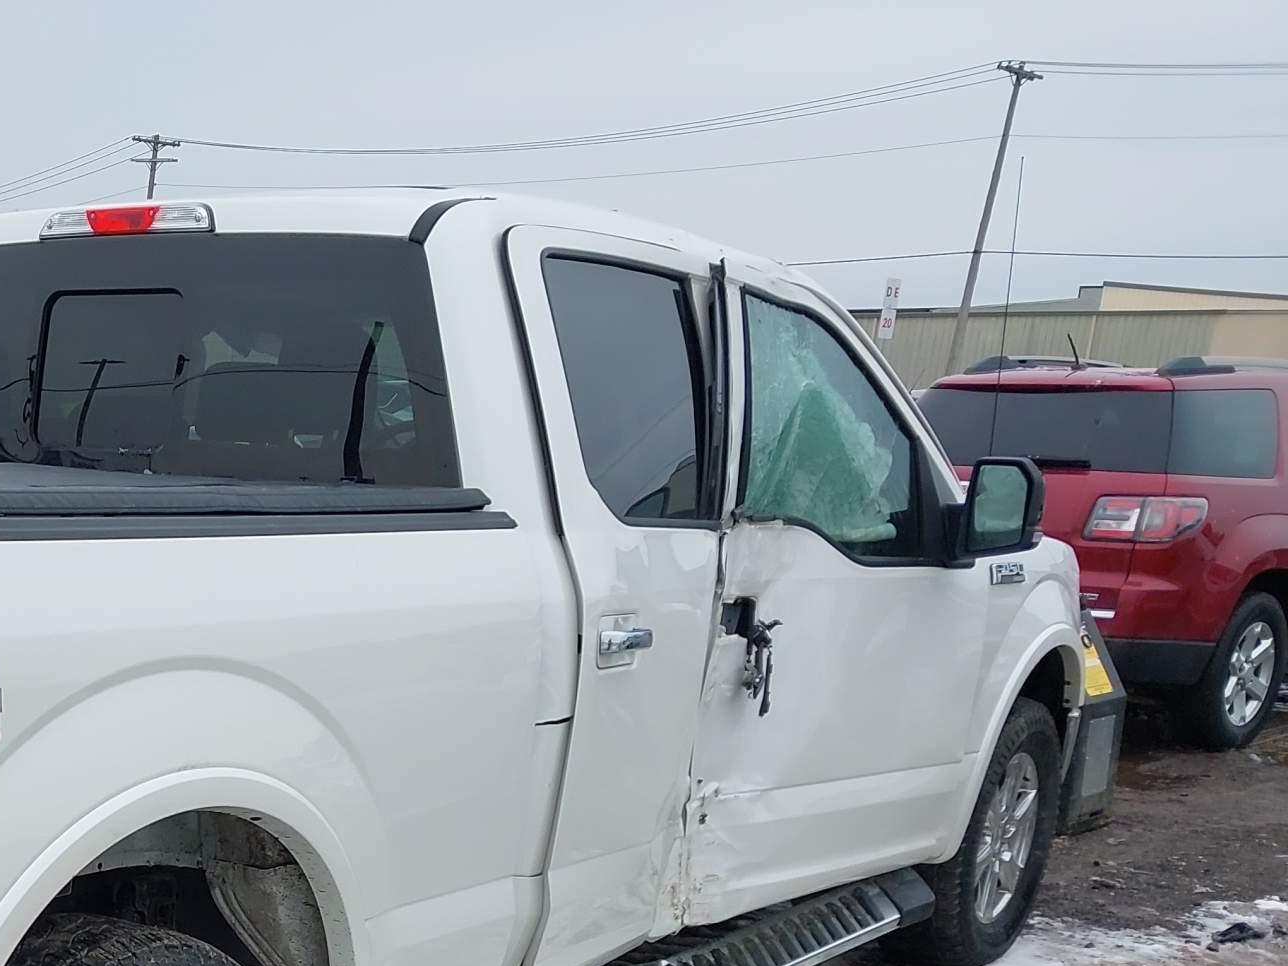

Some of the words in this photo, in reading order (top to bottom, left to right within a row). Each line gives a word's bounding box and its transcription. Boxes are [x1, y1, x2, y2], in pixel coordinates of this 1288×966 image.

[886, 286, 893, 297] D
[894, 287, 900, 298] E
[882, 318, 893, 329] 20
